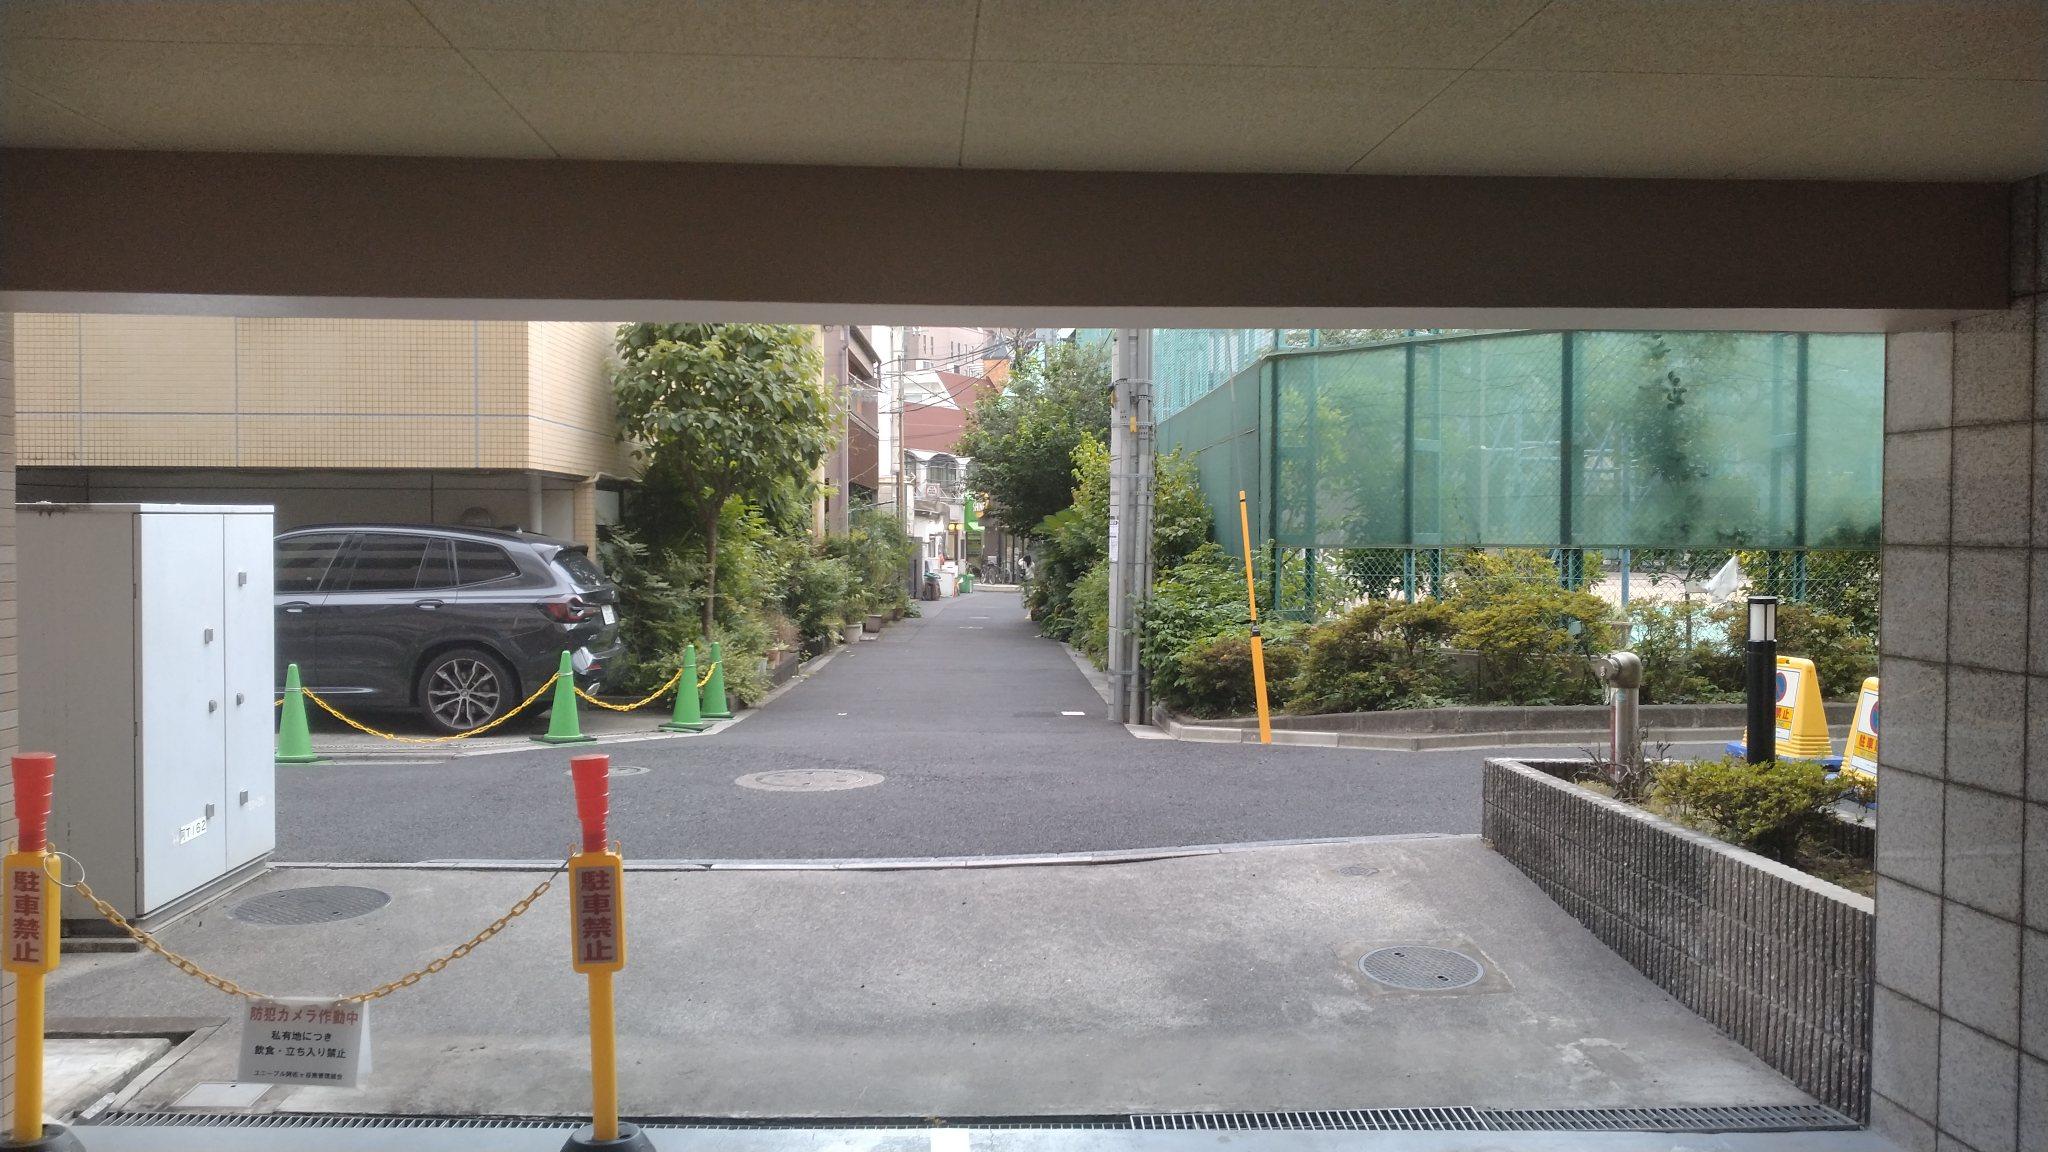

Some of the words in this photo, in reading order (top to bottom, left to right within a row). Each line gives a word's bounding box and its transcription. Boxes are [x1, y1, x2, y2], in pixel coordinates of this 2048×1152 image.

[1859, 734, 1878, 752] 駐車
[12, 870, 40, 963] 駐車禁止
[581, 870, 612, 961] 駐車禁止
[250, 1006, 359, 1025] 防犯カメラ作動中
[271, 1030, 332, 1042] 私有地につき
[254, 1045, 347, 1059] 飲食・立ち入り禁止
